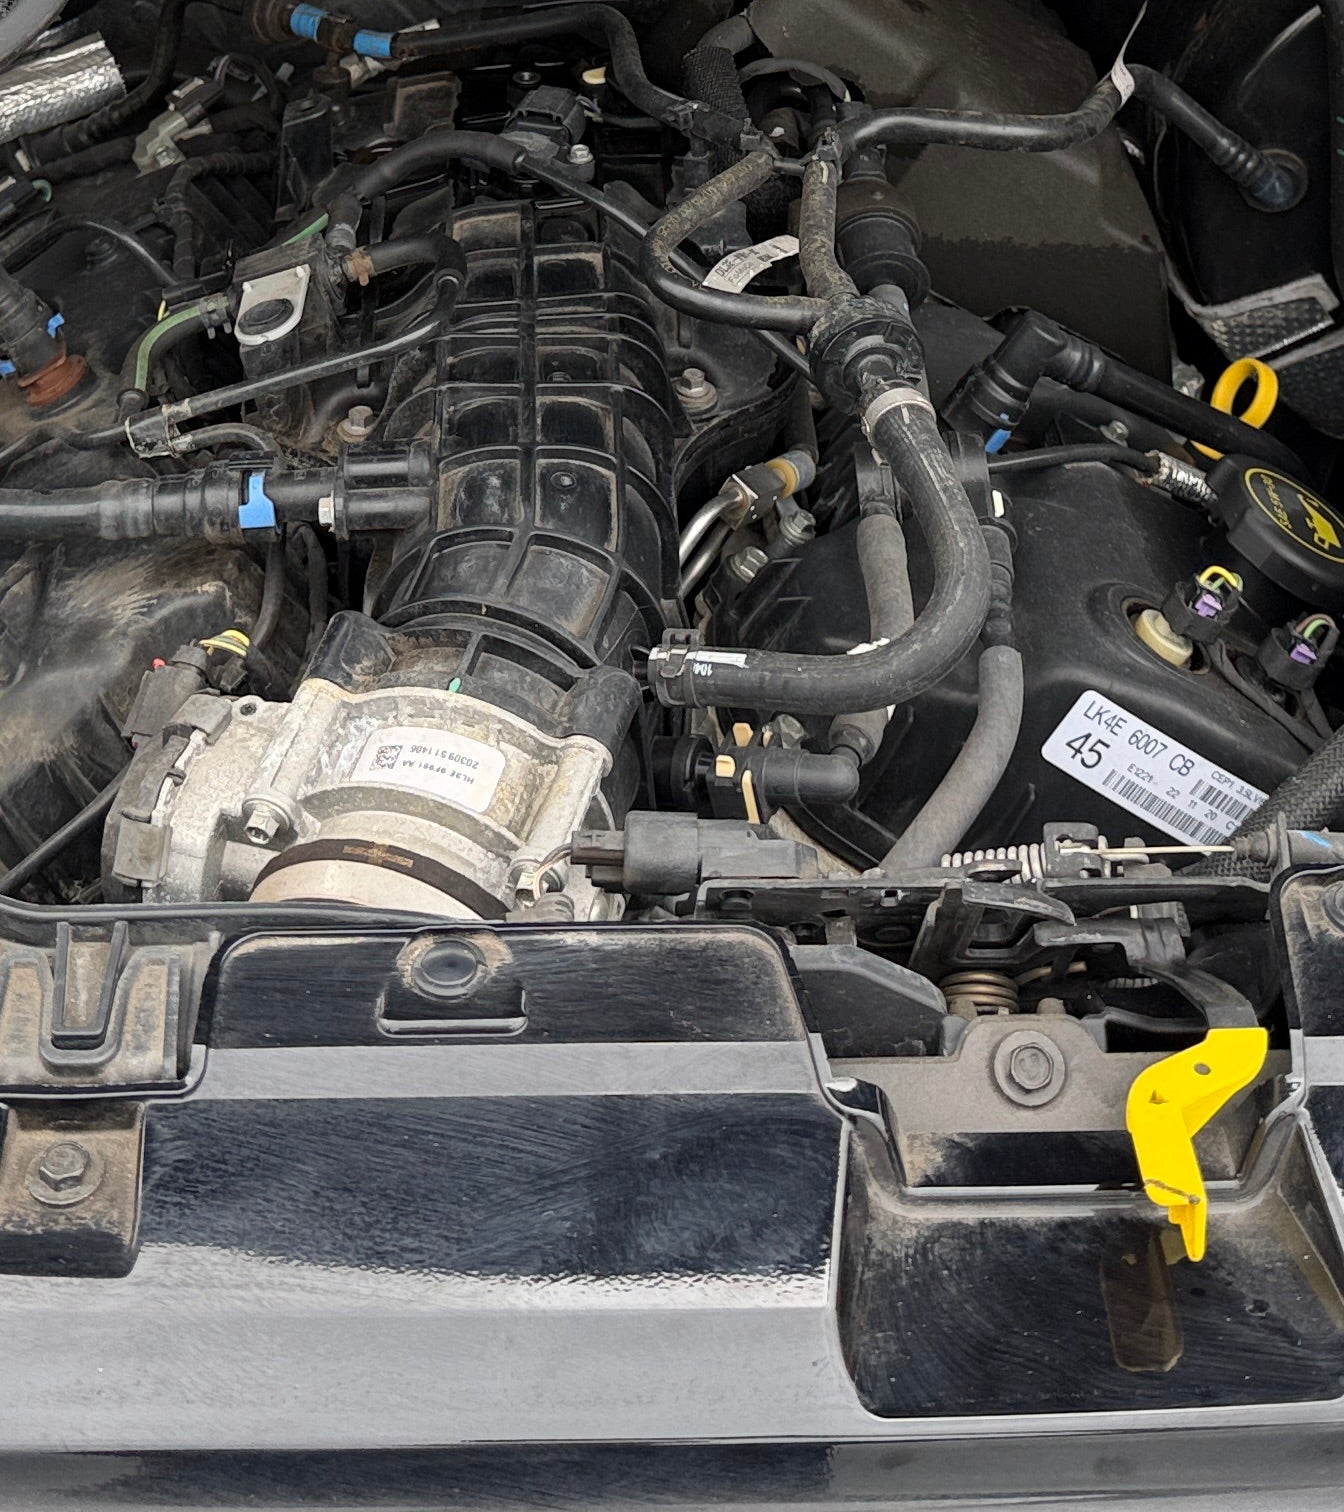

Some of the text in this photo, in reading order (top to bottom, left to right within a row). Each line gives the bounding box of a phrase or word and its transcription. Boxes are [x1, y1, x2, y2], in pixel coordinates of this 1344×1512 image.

[1065, 732, 1110, 769] 45
[1083, 700, 1195, 777] LK4E 6007 CB
[1166, 786, 1180, 799] 22
[1205, 805, 1217, 820] 20
